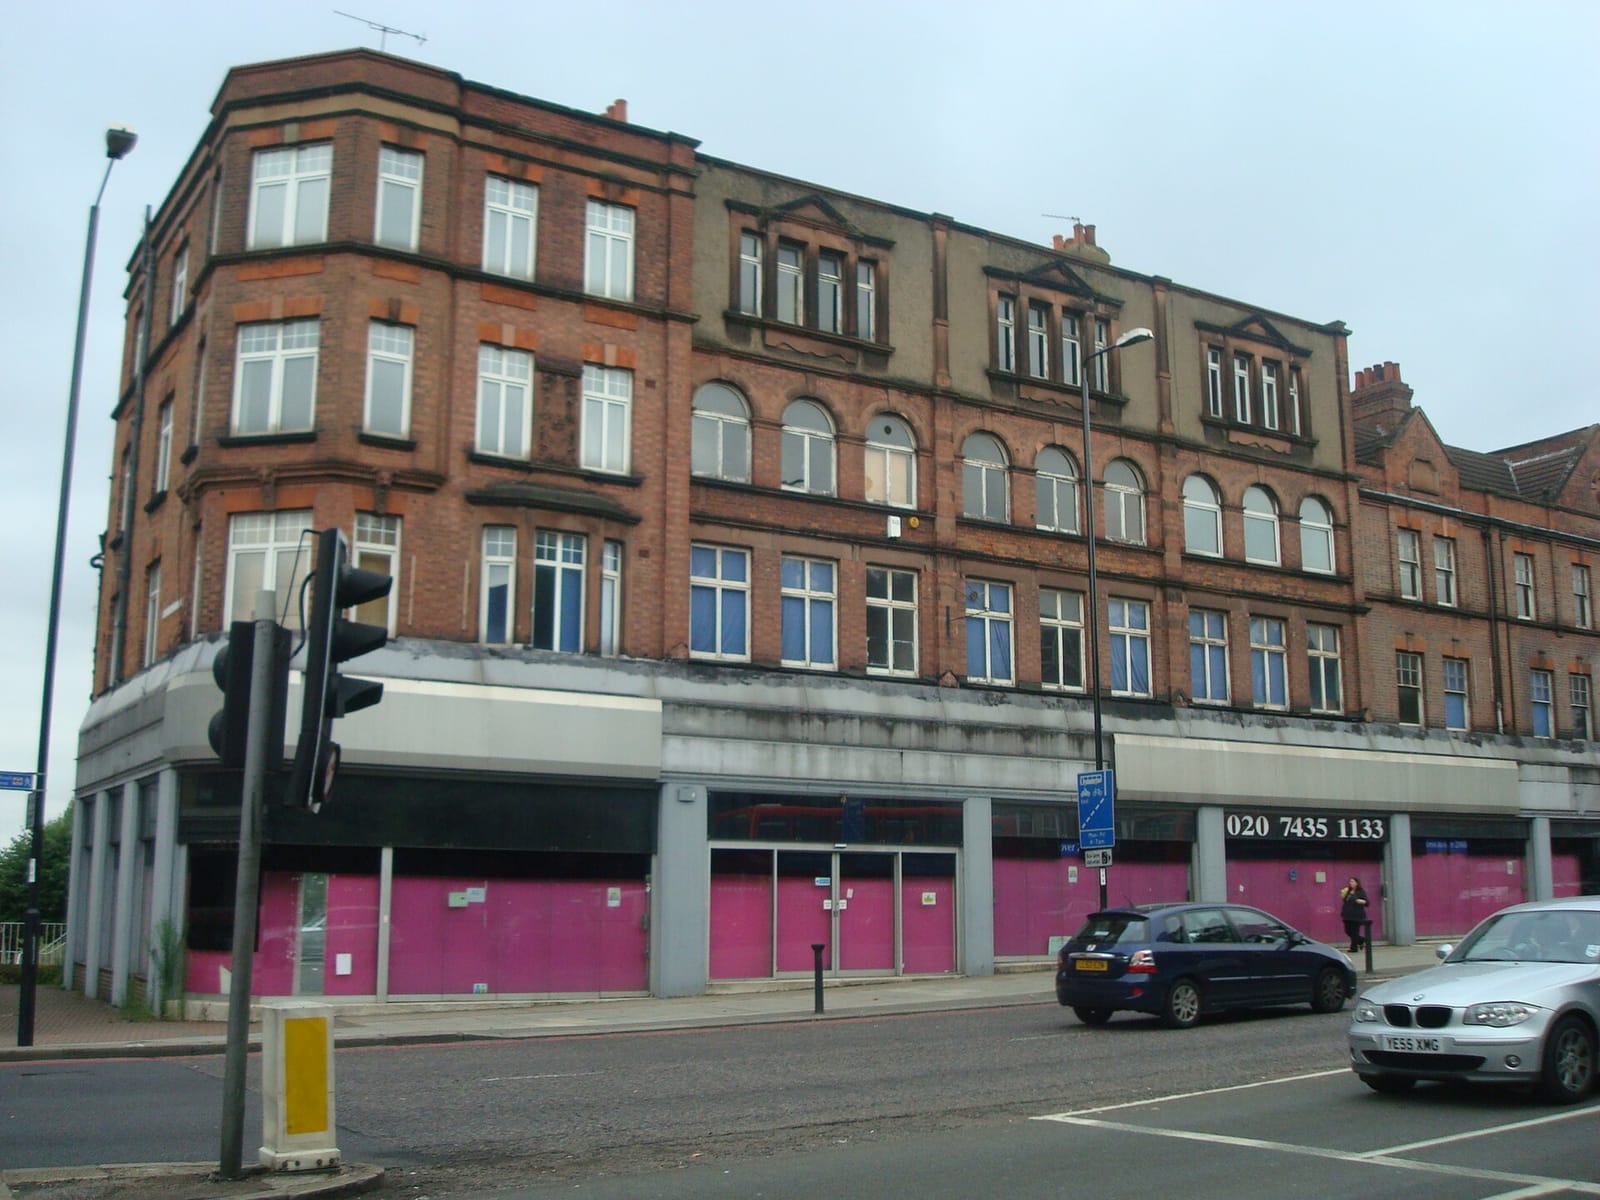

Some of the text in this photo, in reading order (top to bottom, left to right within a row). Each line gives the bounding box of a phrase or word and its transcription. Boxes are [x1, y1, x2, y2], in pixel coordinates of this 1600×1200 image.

[1226, 814, 1384, 839] 020 7435 1133
